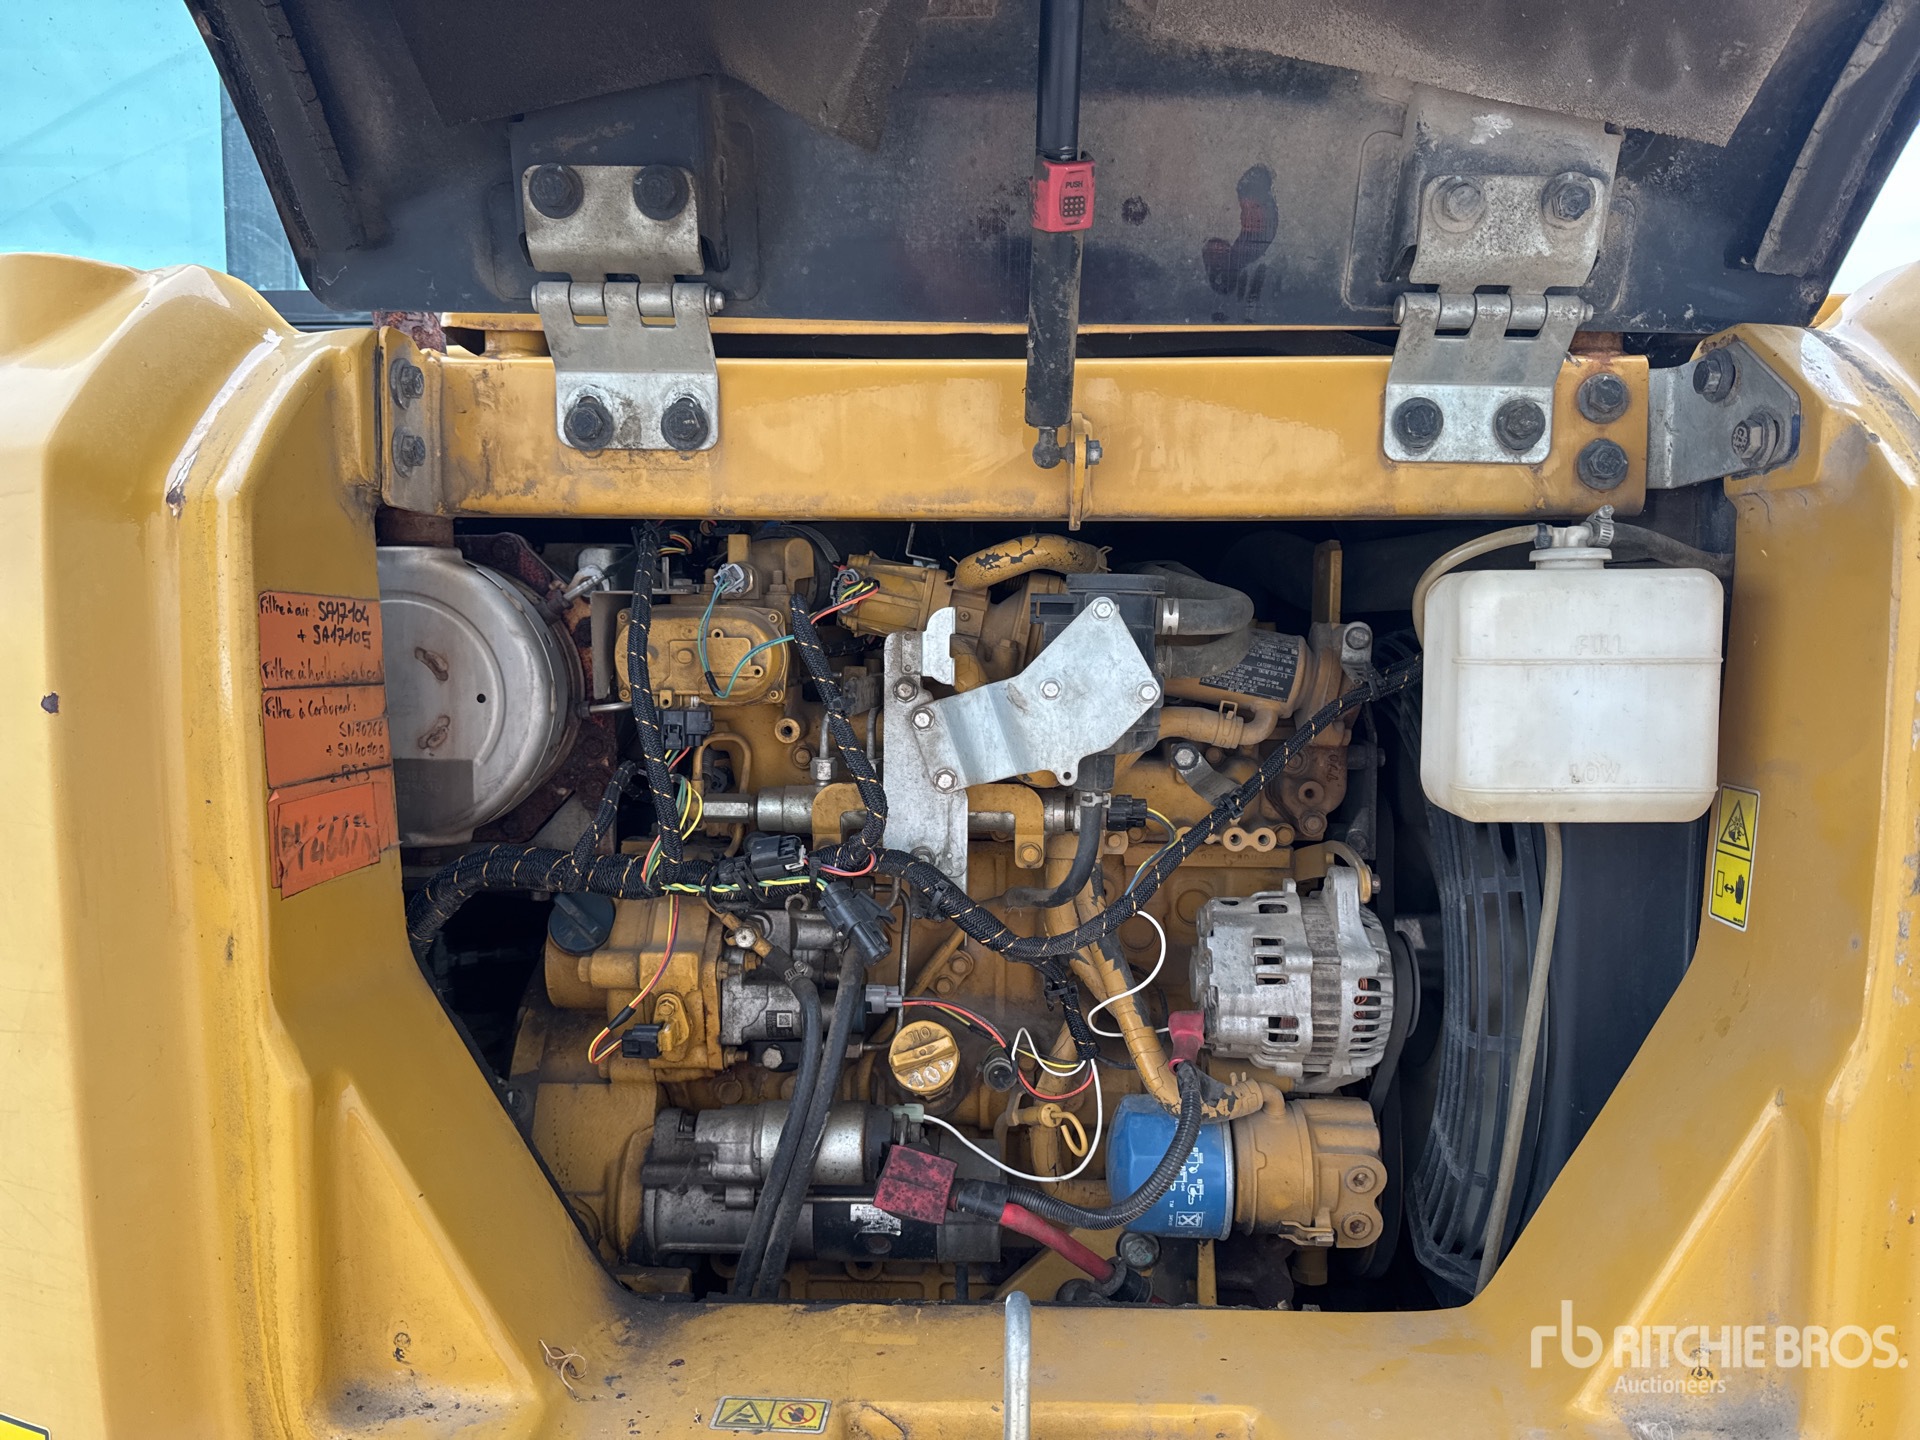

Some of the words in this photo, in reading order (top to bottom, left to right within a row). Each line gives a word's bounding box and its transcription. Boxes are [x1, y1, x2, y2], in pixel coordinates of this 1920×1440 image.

[1065, 181, 1083, 189] PUSH
[1575, 634, 1625, 655] FULL
[1570, 763, 1621, 784] LOW
